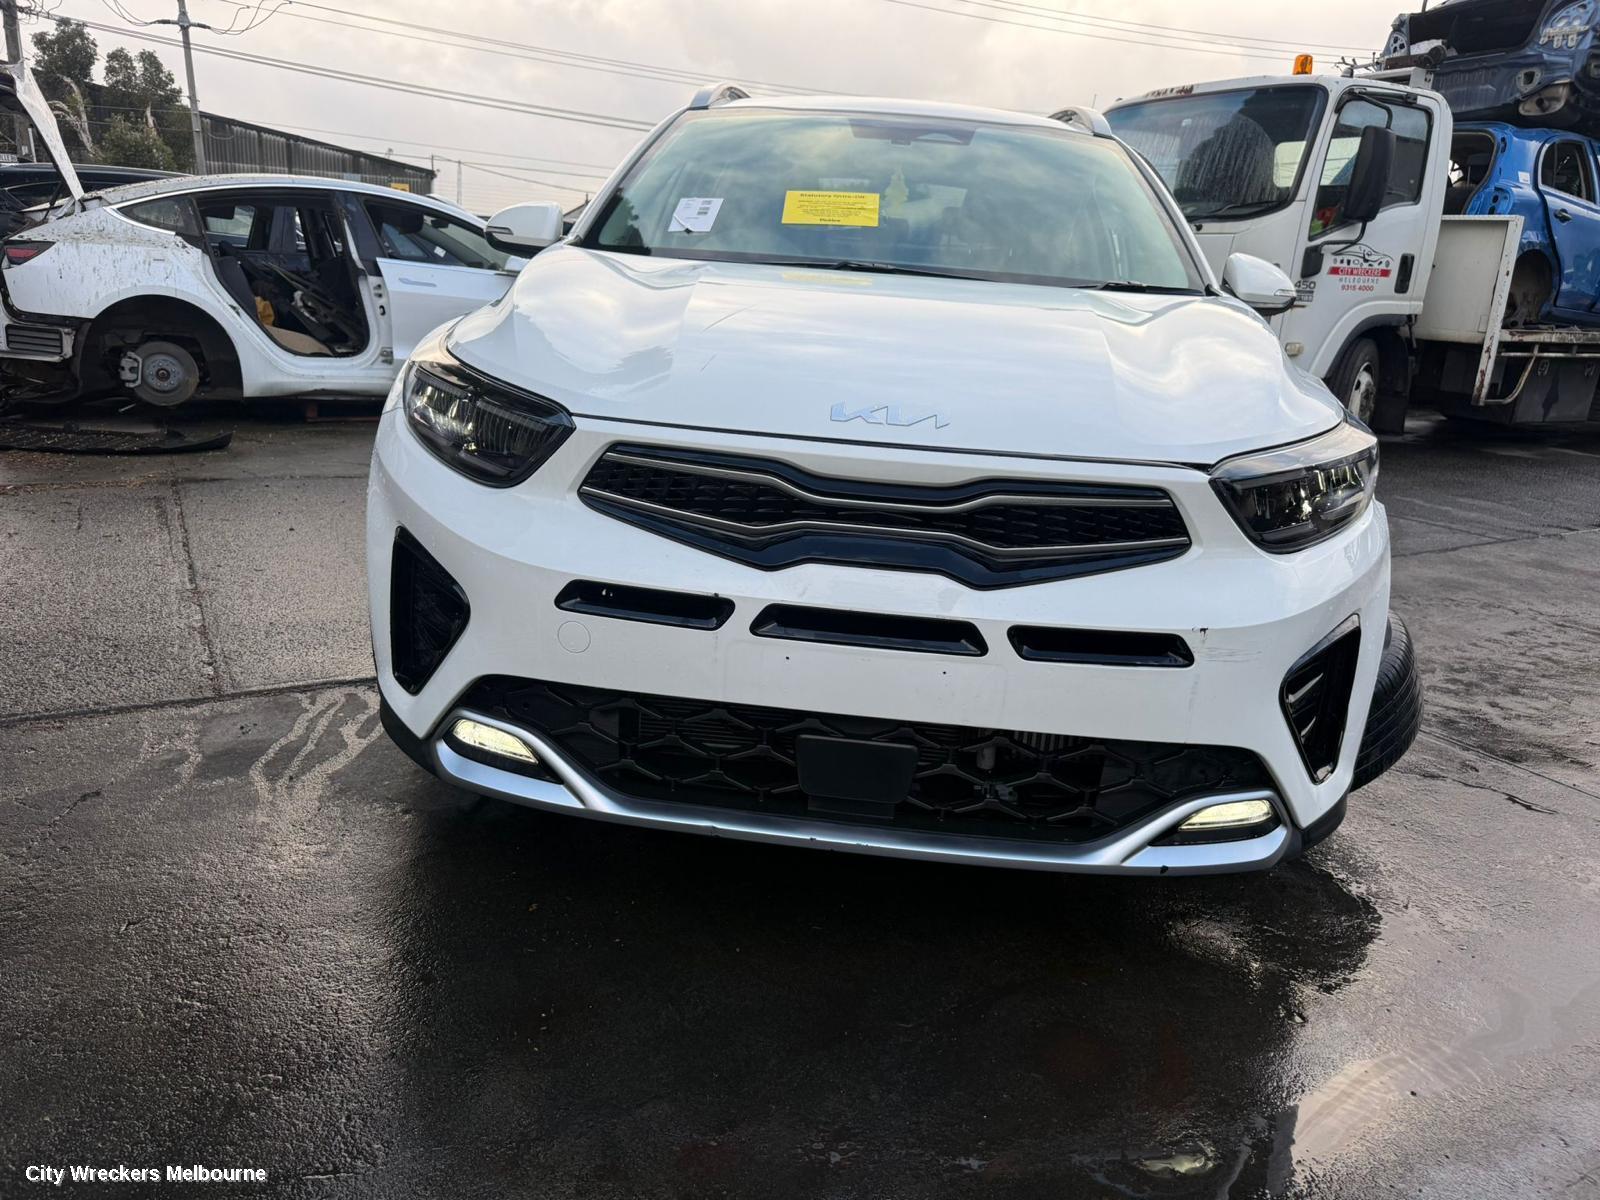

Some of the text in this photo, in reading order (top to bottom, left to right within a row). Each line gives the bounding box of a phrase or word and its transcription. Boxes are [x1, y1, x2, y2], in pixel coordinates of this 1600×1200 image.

[1338, 266, 1382, 277] CITY WRECKERS
[1294, 280, 1316, 289] 450
[1338, 277, 1380, 285] MELBOURNE
